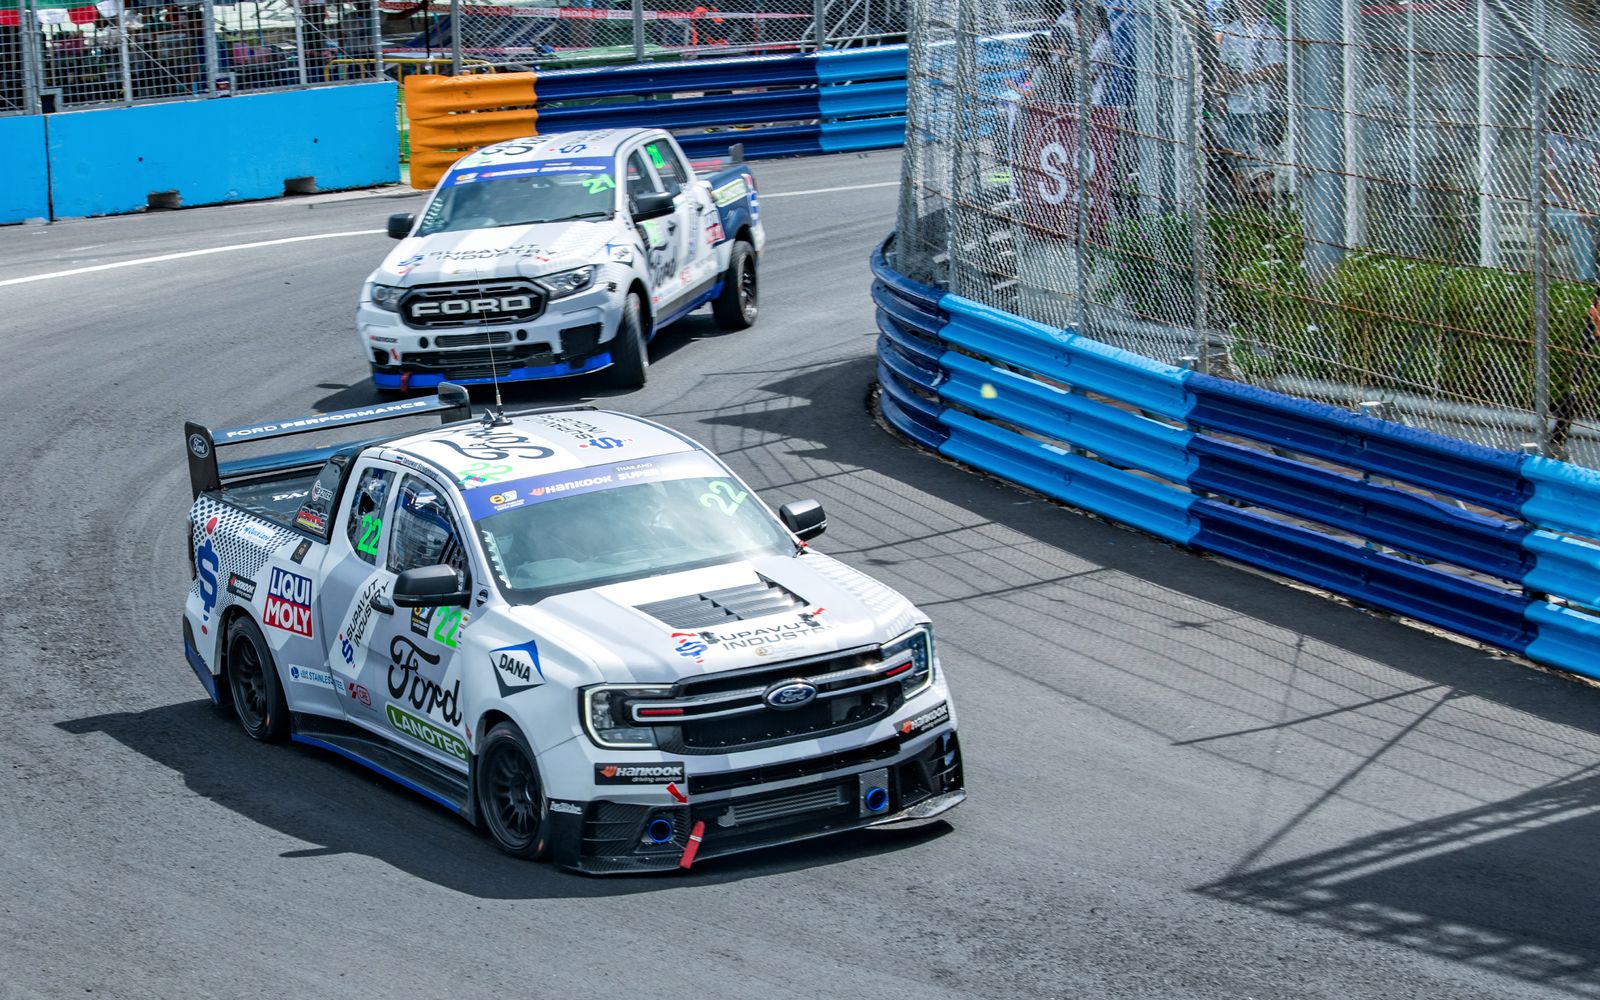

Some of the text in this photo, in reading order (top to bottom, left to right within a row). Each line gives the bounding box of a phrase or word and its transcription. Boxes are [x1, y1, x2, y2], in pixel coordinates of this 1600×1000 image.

[582, 173, 617, 194] 21
[411, 295, 531, 317] FORD
[226, 400, 427, 438] FORD PERFORMANCE
[699, 480, 749, 517] 22
[357, 514, 383, 556] 22
[269, 568, 311, 606] LIQUI
[265, 599, 311, 634] MOLY
[346, 578, 378, 642] SUPAVUT
[433, 605, 462, 649] 22
[387, 635, 463, 727] Ford
[499, 653, 531, 682] DANA
[390, 708, 467, 759] LANOTEC
